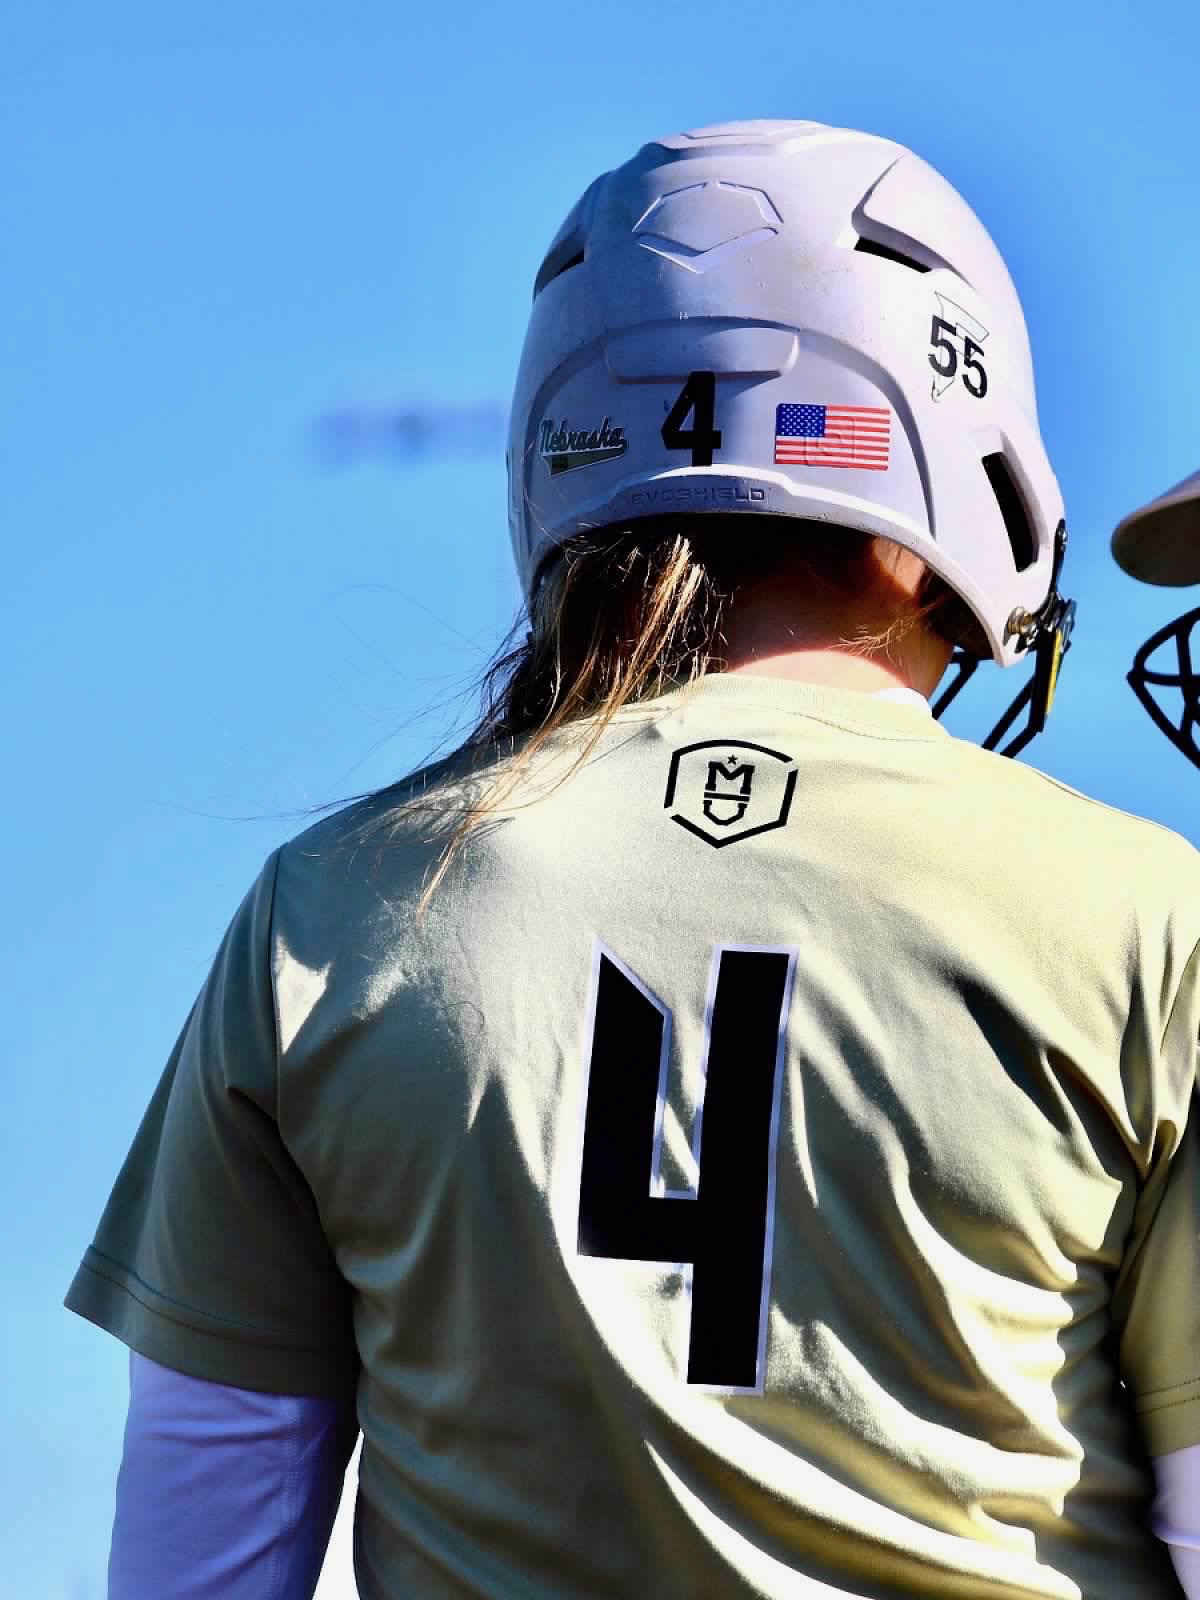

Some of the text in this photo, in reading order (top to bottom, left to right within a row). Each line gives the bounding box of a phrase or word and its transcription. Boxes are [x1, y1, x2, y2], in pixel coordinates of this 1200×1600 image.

[928, 314, 988, 399] 55
[539, 416, 628, 454] Nebraska
[660, 370, 722, 467] 4
[577, 938, 799, 1396] 4
